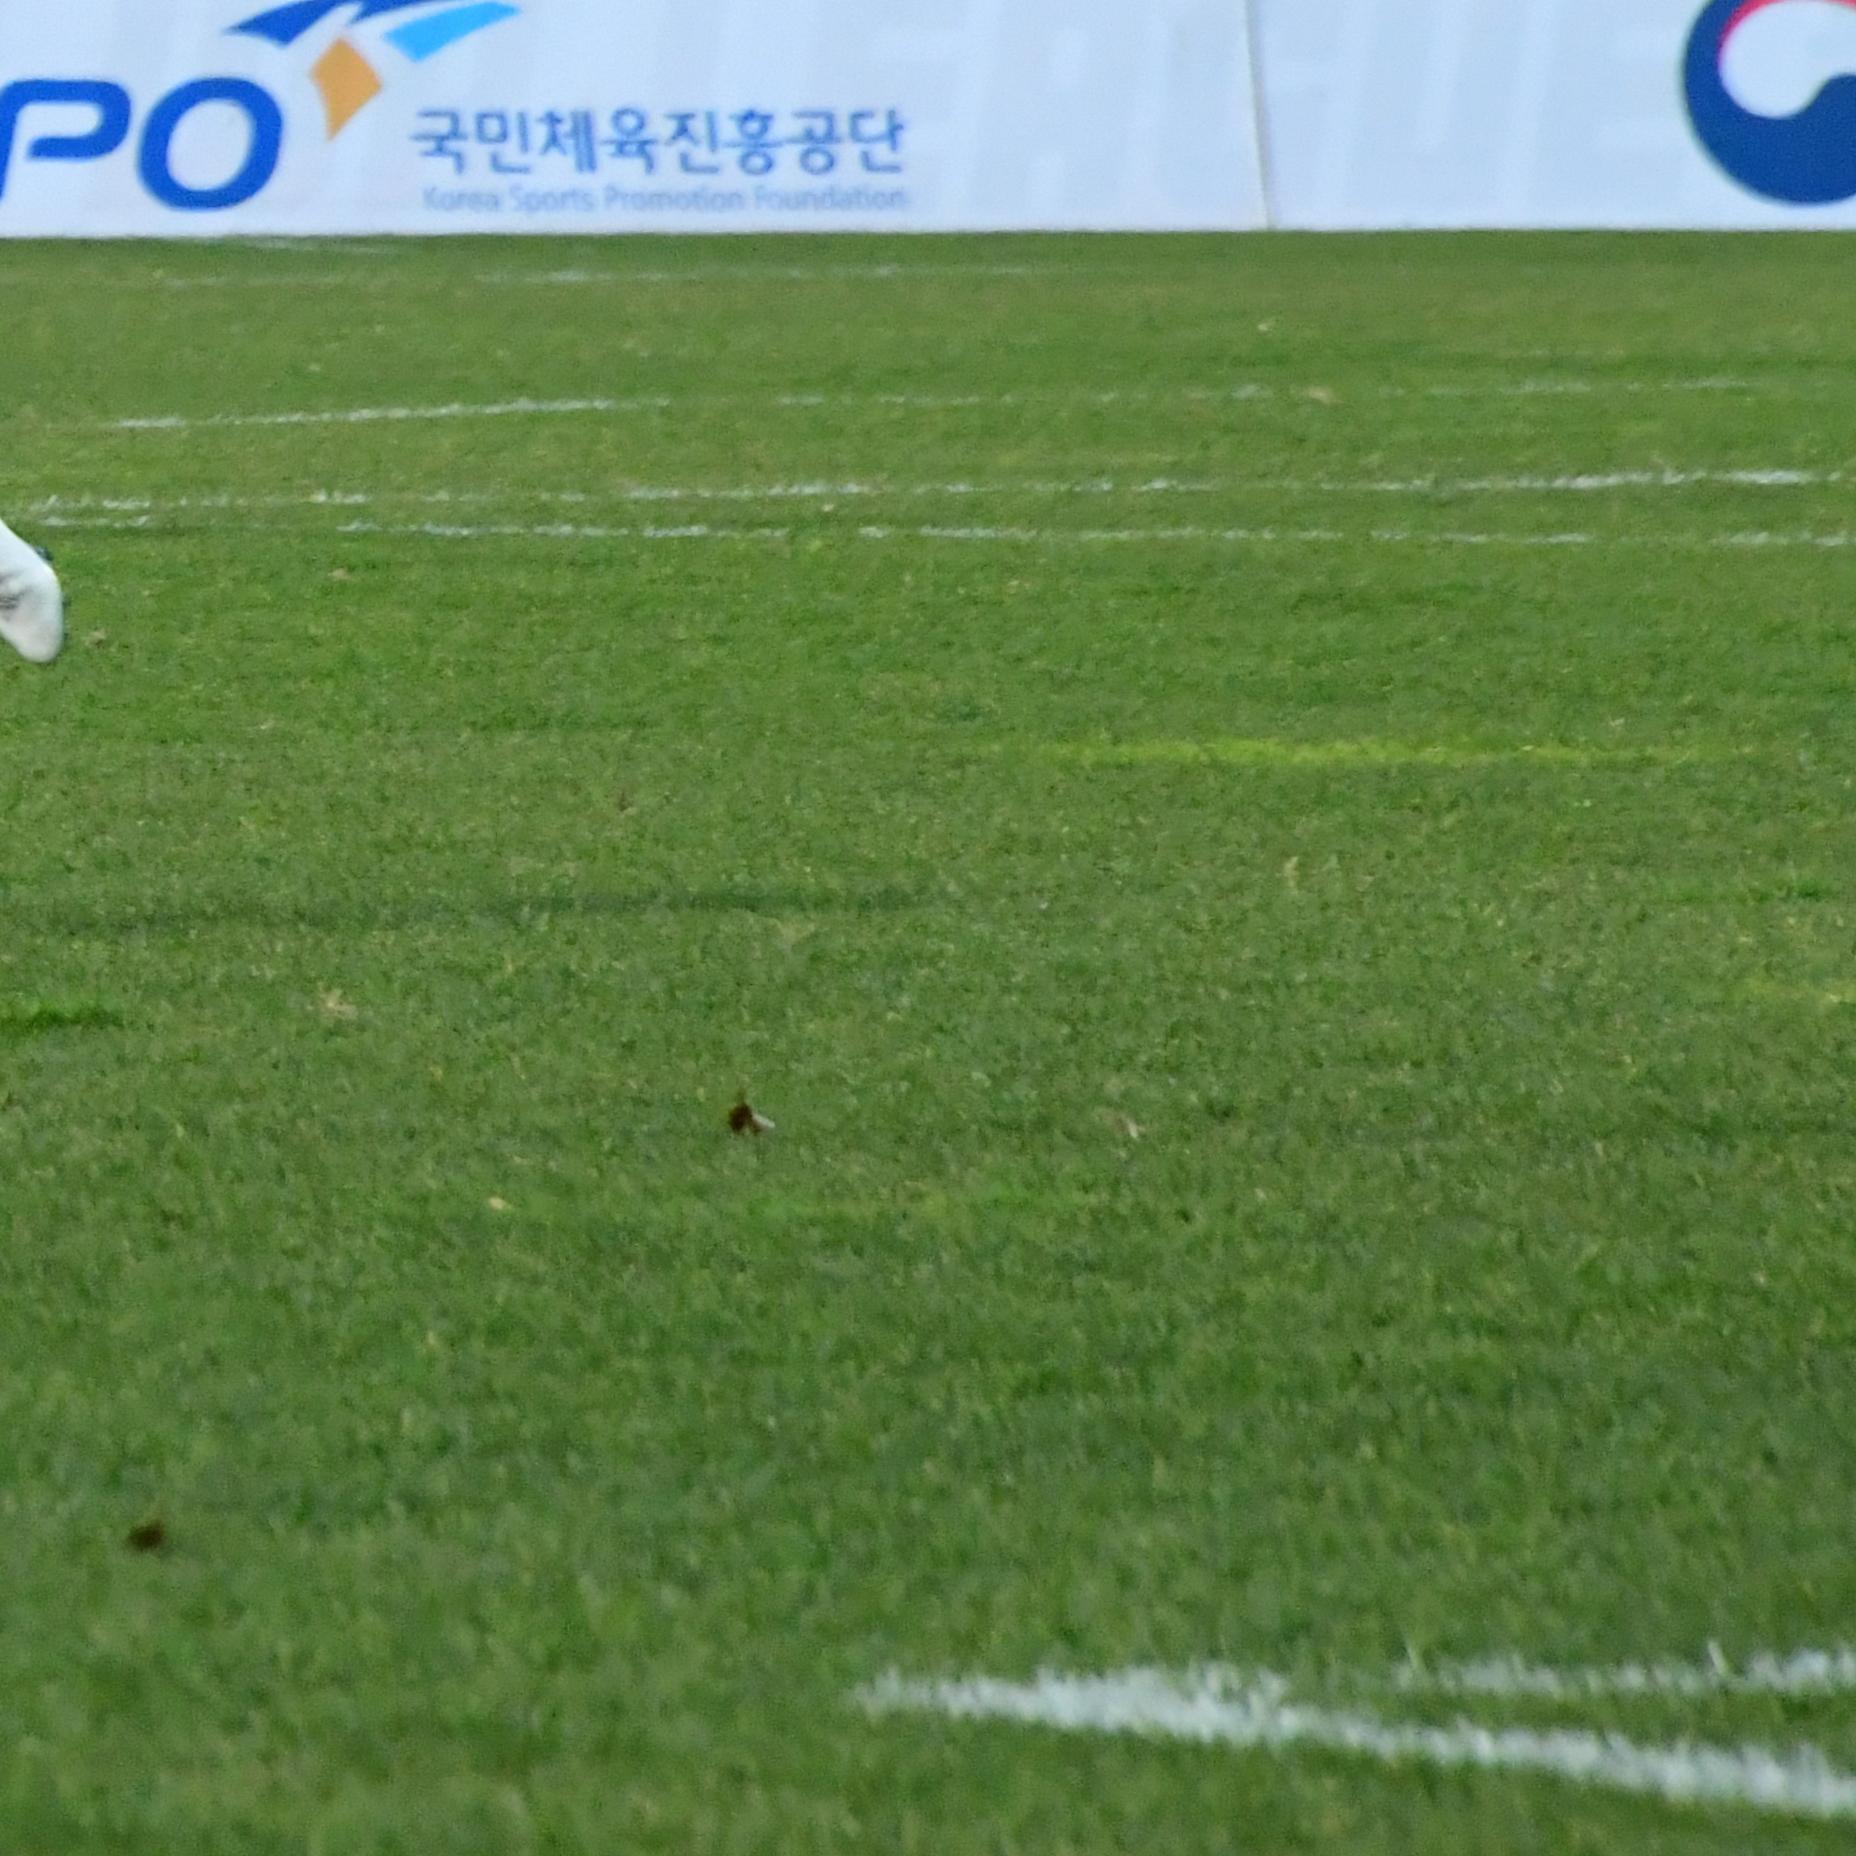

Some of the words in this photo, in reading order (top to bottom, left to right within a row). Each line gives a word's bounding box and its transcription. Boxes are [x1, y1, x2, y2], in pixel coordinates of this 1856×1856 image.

[410, 108, 906, 177] 국민체육진흥공단
[423, 187, 500, 212] Korea
[509, 186, 595, 217] Sports
[603, 187, 746, 212] Promotion
[755, 185, 908, 212] Foundation
